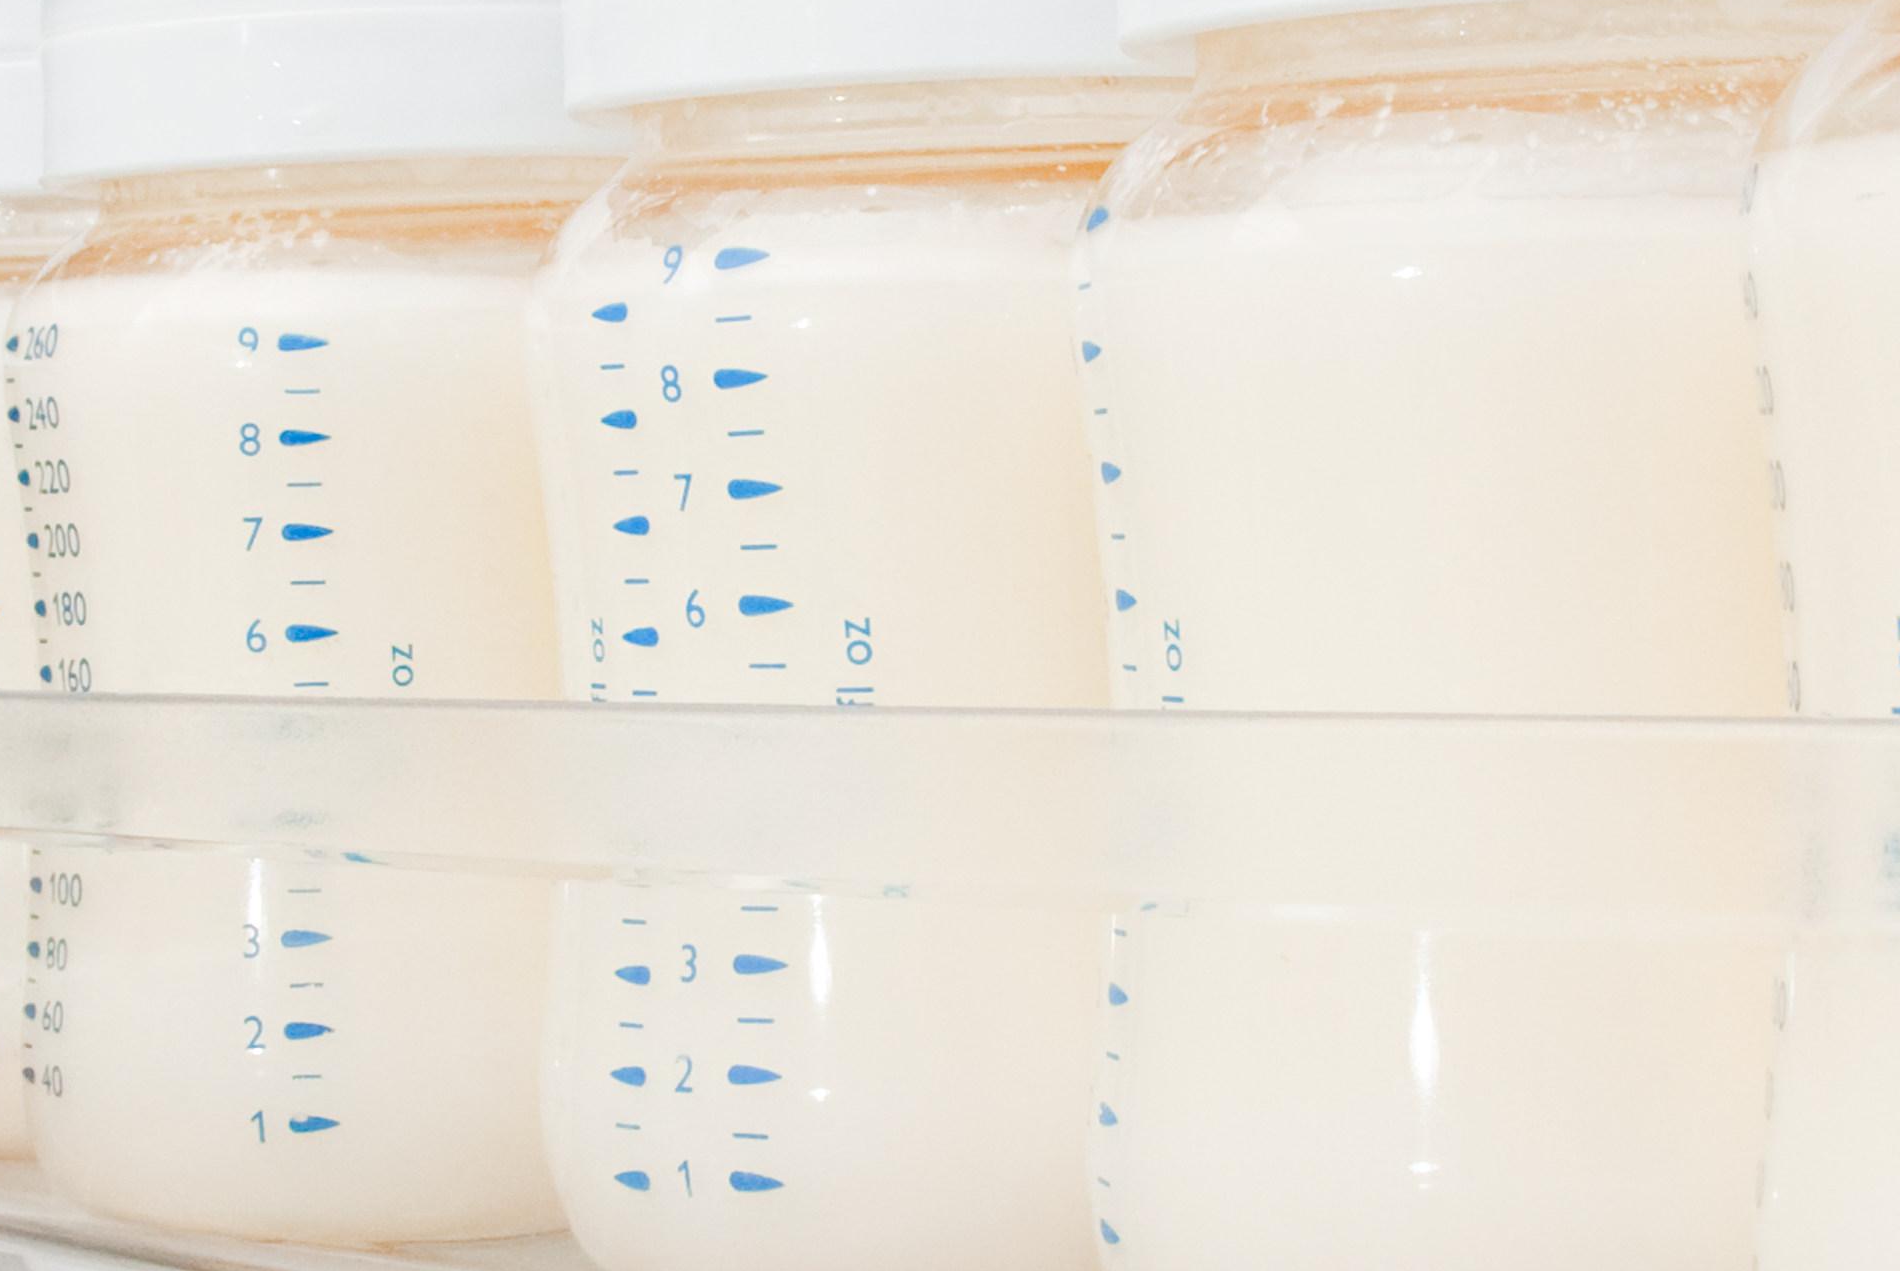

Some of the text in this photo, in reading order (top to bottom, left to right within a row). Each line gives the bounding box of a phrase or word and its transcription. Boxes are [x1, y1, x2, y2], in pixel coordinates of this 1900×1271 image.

[663, 245, 683, 284] 9
[24, 323, 59, 360] 260
[238, 327, 259, 352] 9
[661, 365, 681, 403] 8
[26, 396, 59, 430] 240
[239, 423, 260, 456] 8
[35, 459, 70, 494] 220
[674, 473, 692, 510] 7
[44, 523, 80, 558] 200
[243, 517, 263, 551] 7
[53, 591, 86, 626] 180
[686, 590, 705, 628] 6
[246, 620, 266, 653] 6
[844, 617, 873, 665] oz
[58, 657, 91, 692] 160
[50, 873, 83, 908] 100
[47, 937, 67, 971] 80
[243, 924, 260, 959] 3
[680, 944, 697, 983] 3
[42, 1001, 63, 1033] 60
[244, 1015, 265, 1049] 2
[42, 1065, 63, 1097] 40
[675, 1057, 693, 1093] 2
[251, 1111, 265, 1143] 1
[678, 1160, 691, 1196] 1
